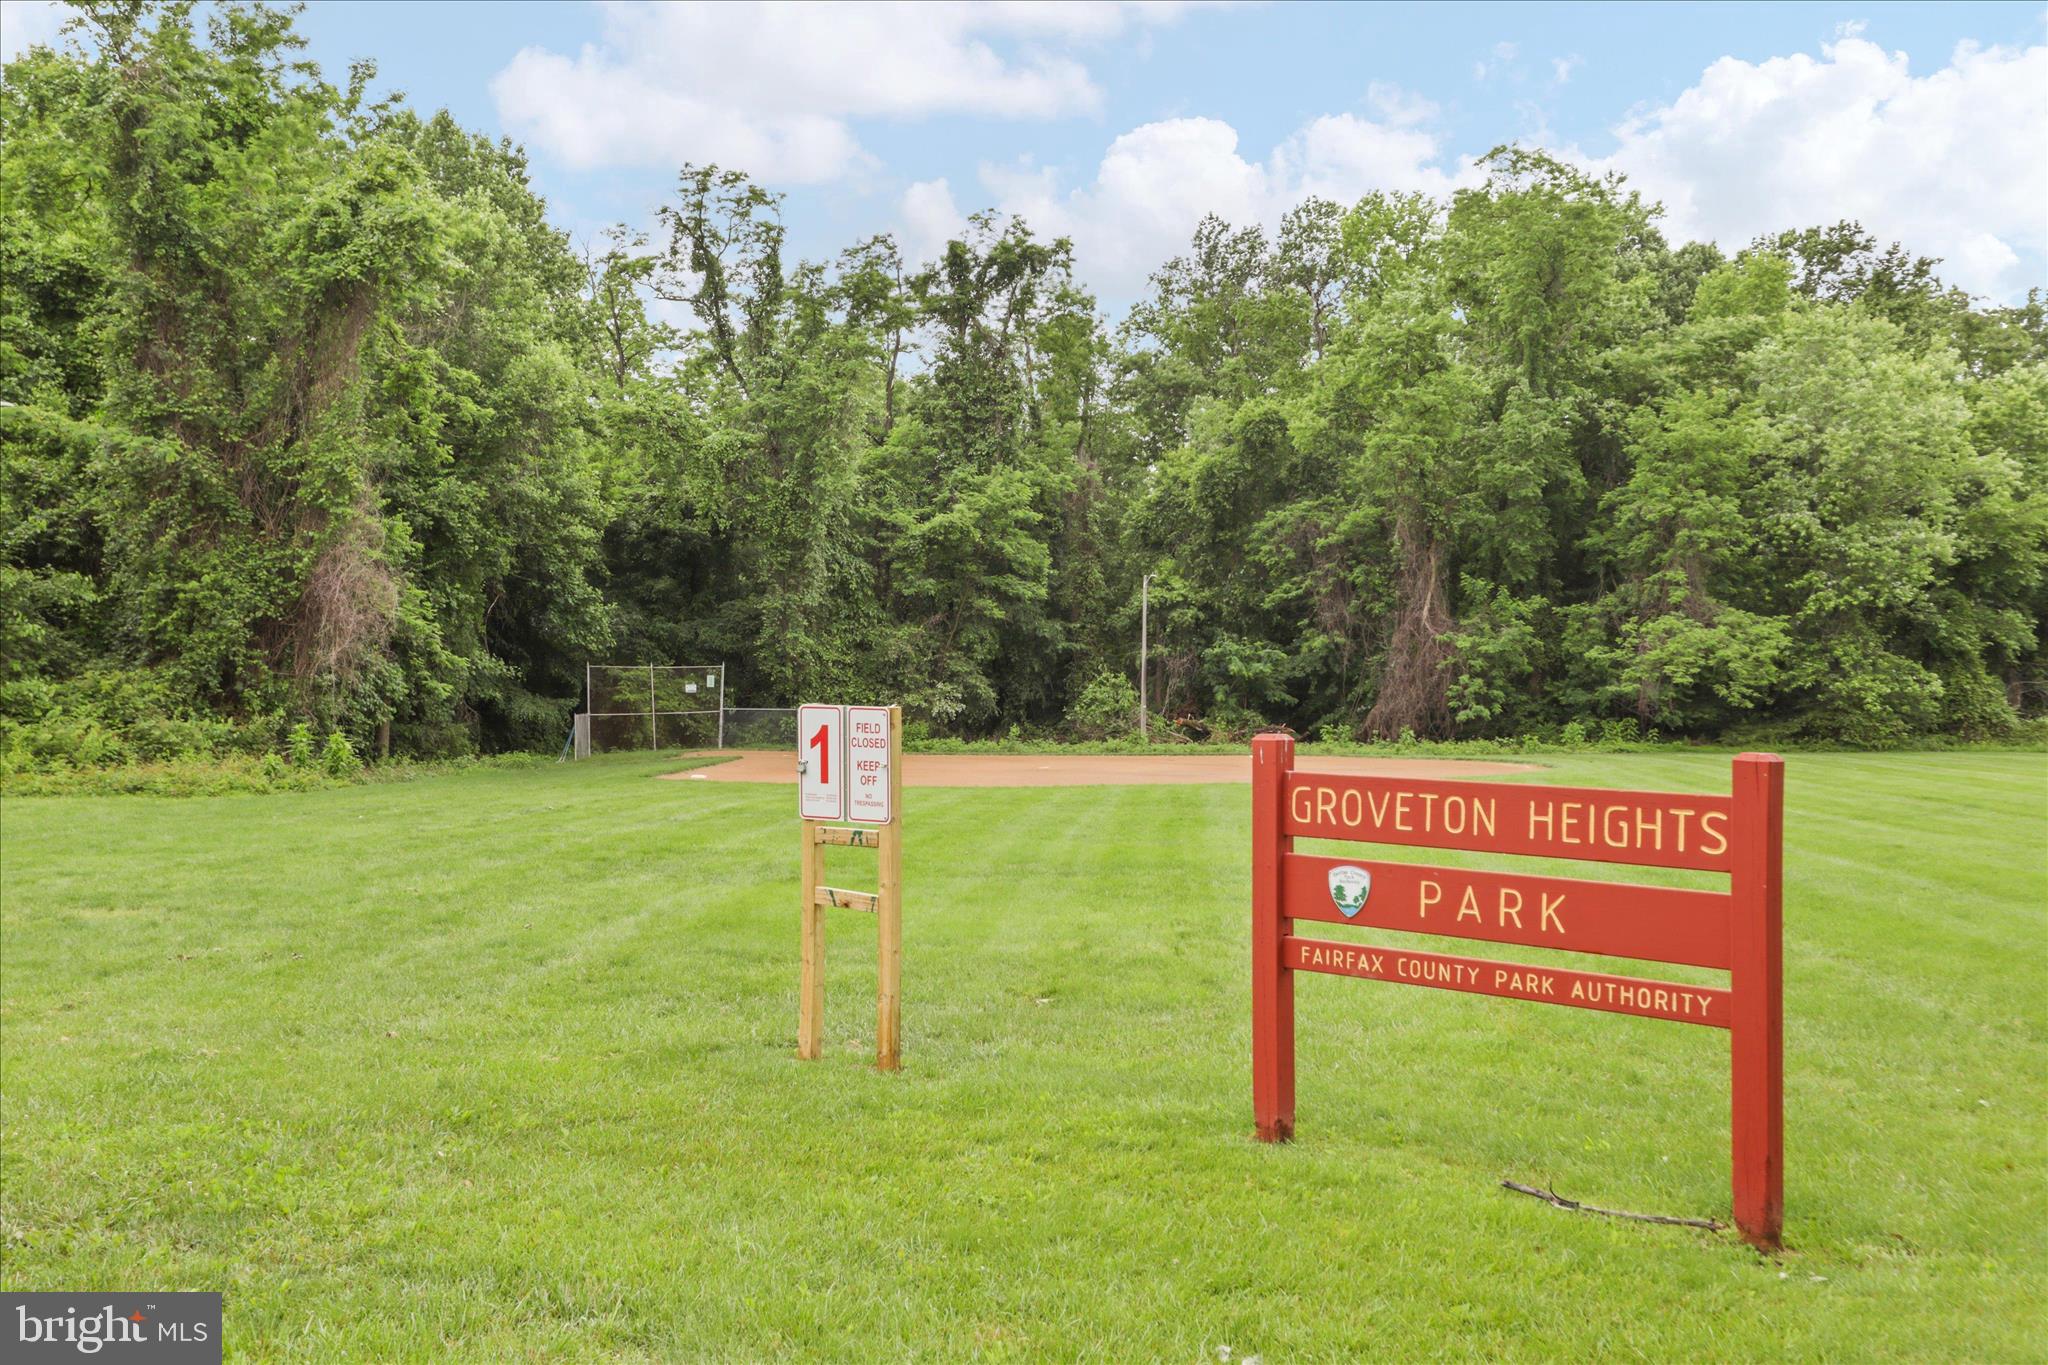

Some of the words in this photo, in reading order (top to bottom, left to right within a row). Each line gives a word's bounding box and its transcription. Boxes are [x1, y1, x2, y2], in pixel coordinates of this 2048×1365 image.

[851, 737, 886, 749] CLOSED
[856, 722, 881, 734] FIELD
[810, 724, 829, 784] 1
[856, 760, 880, 772] KEEP
[860, 775, 877, 787] OFF
[1291, 786, 1496, 837] GROVETON
[1529, 801, 1729, 856] HEIGHTS
[1419, 880, 1567, 934] PARK
[1301, 946, 1384, 975] FAIRFAX
[1398, 957, 1480, 986] COUNTY
[1495, 970, 1554, 996] PARK
[1571, 981, 1713, 1017] AUTHORITY
